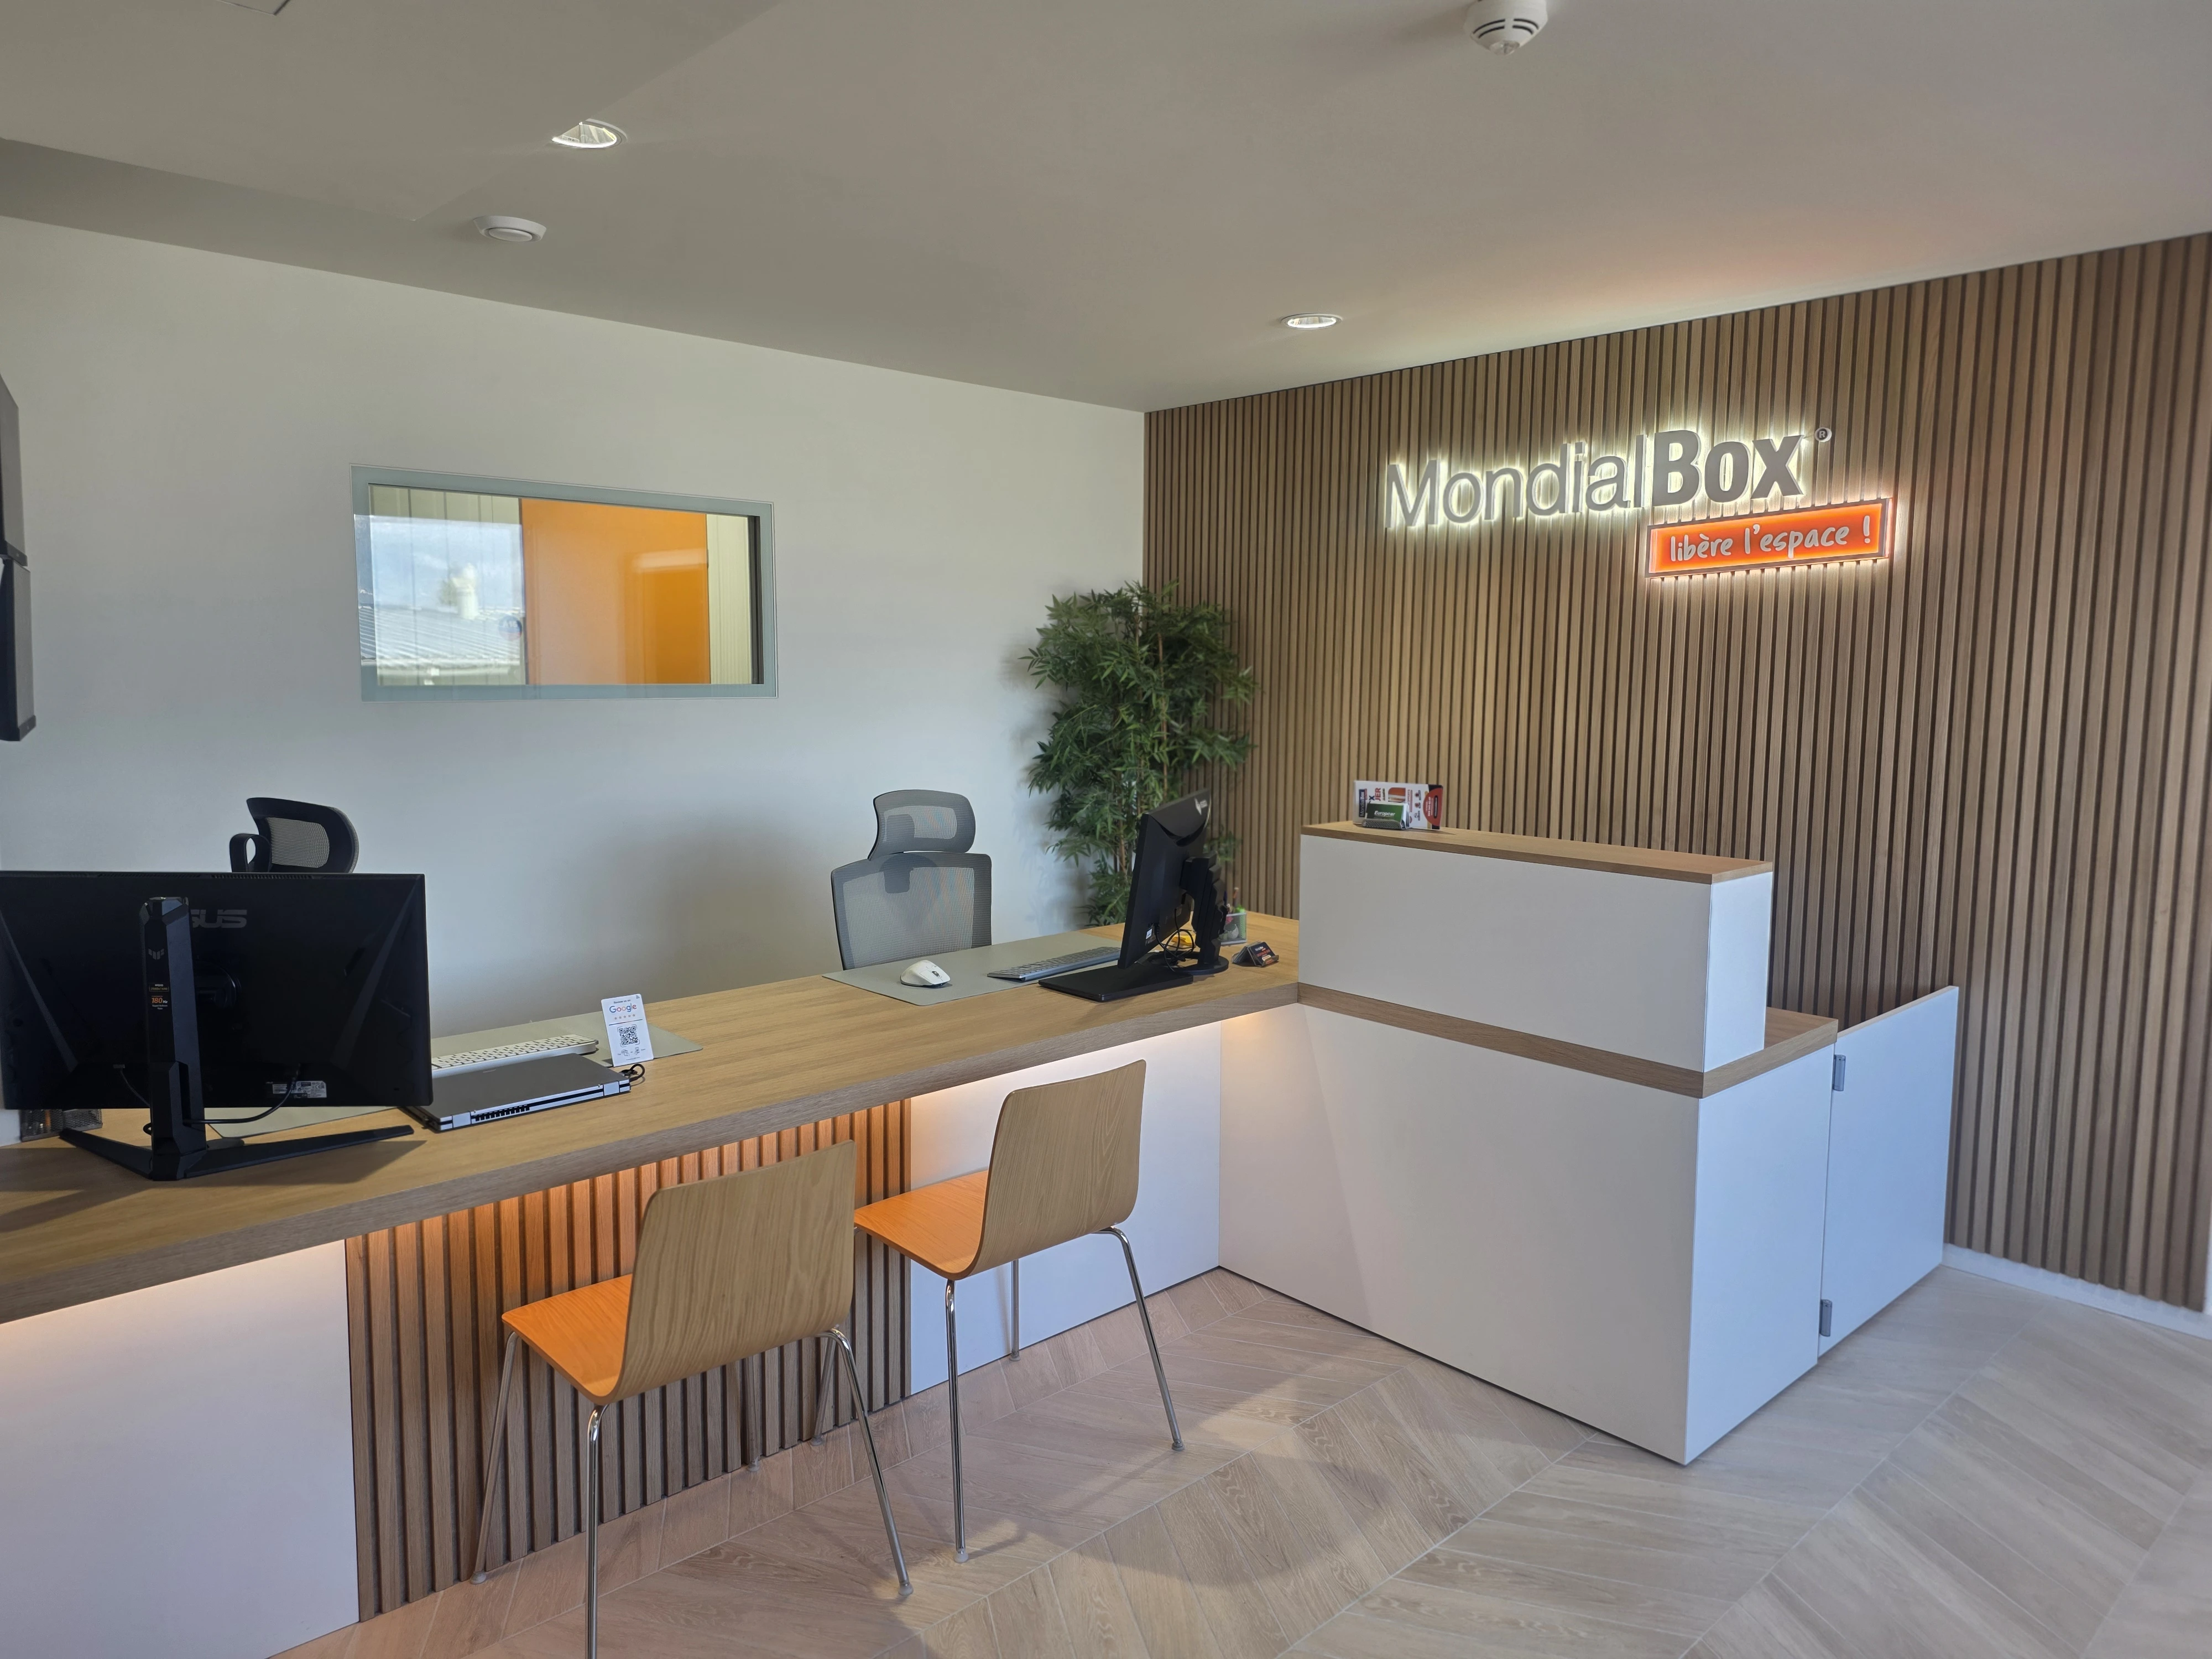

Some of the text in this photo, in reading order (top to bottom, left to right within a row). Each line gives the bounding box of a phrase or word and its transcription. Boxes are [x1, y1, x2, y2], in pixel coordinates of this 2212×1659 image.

[1385, 430, 1805, 529] MondialBox
[1670, 533, 1733, 562] libère
[1744, 524, 1850, 559] l'espace
[609, 1003, 637, 1013] Google
